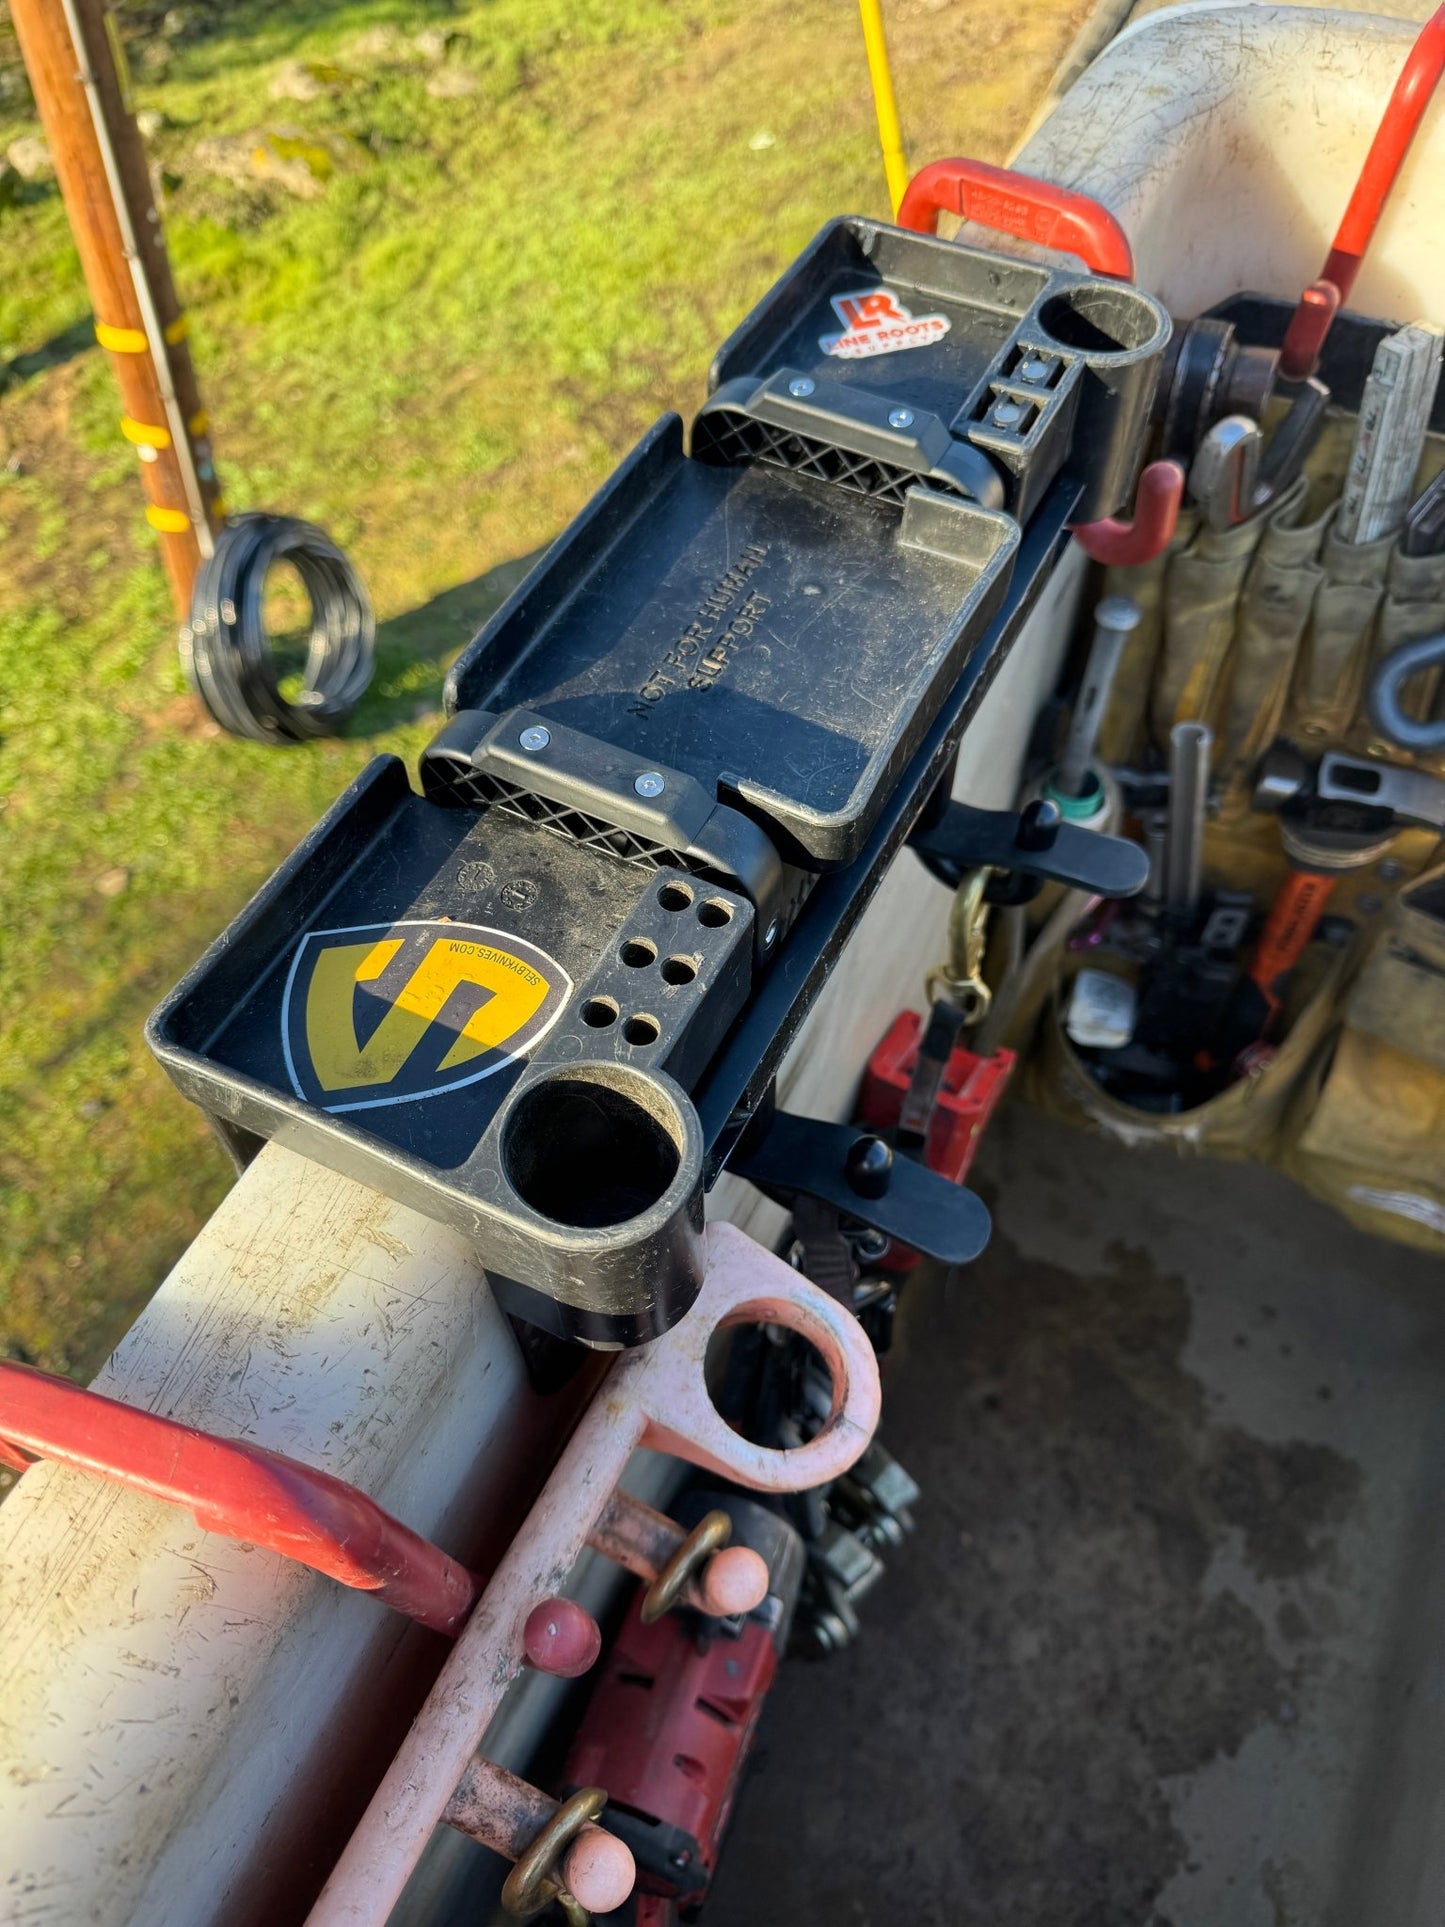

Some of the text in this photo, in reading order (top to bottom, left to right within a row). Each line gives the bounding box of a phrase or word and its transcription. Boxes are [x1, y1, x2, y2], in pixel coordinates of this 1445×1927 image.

[838, 293, 905, 331] LR
[826, 320, 944, 352] LINE ROOTS
[627, 543, 768, 721] NOT FOR HUMAN
[687, 588, 772, 692] SUPPORT
[449, 941, 542, 987] SELBYKNIVES.COM
